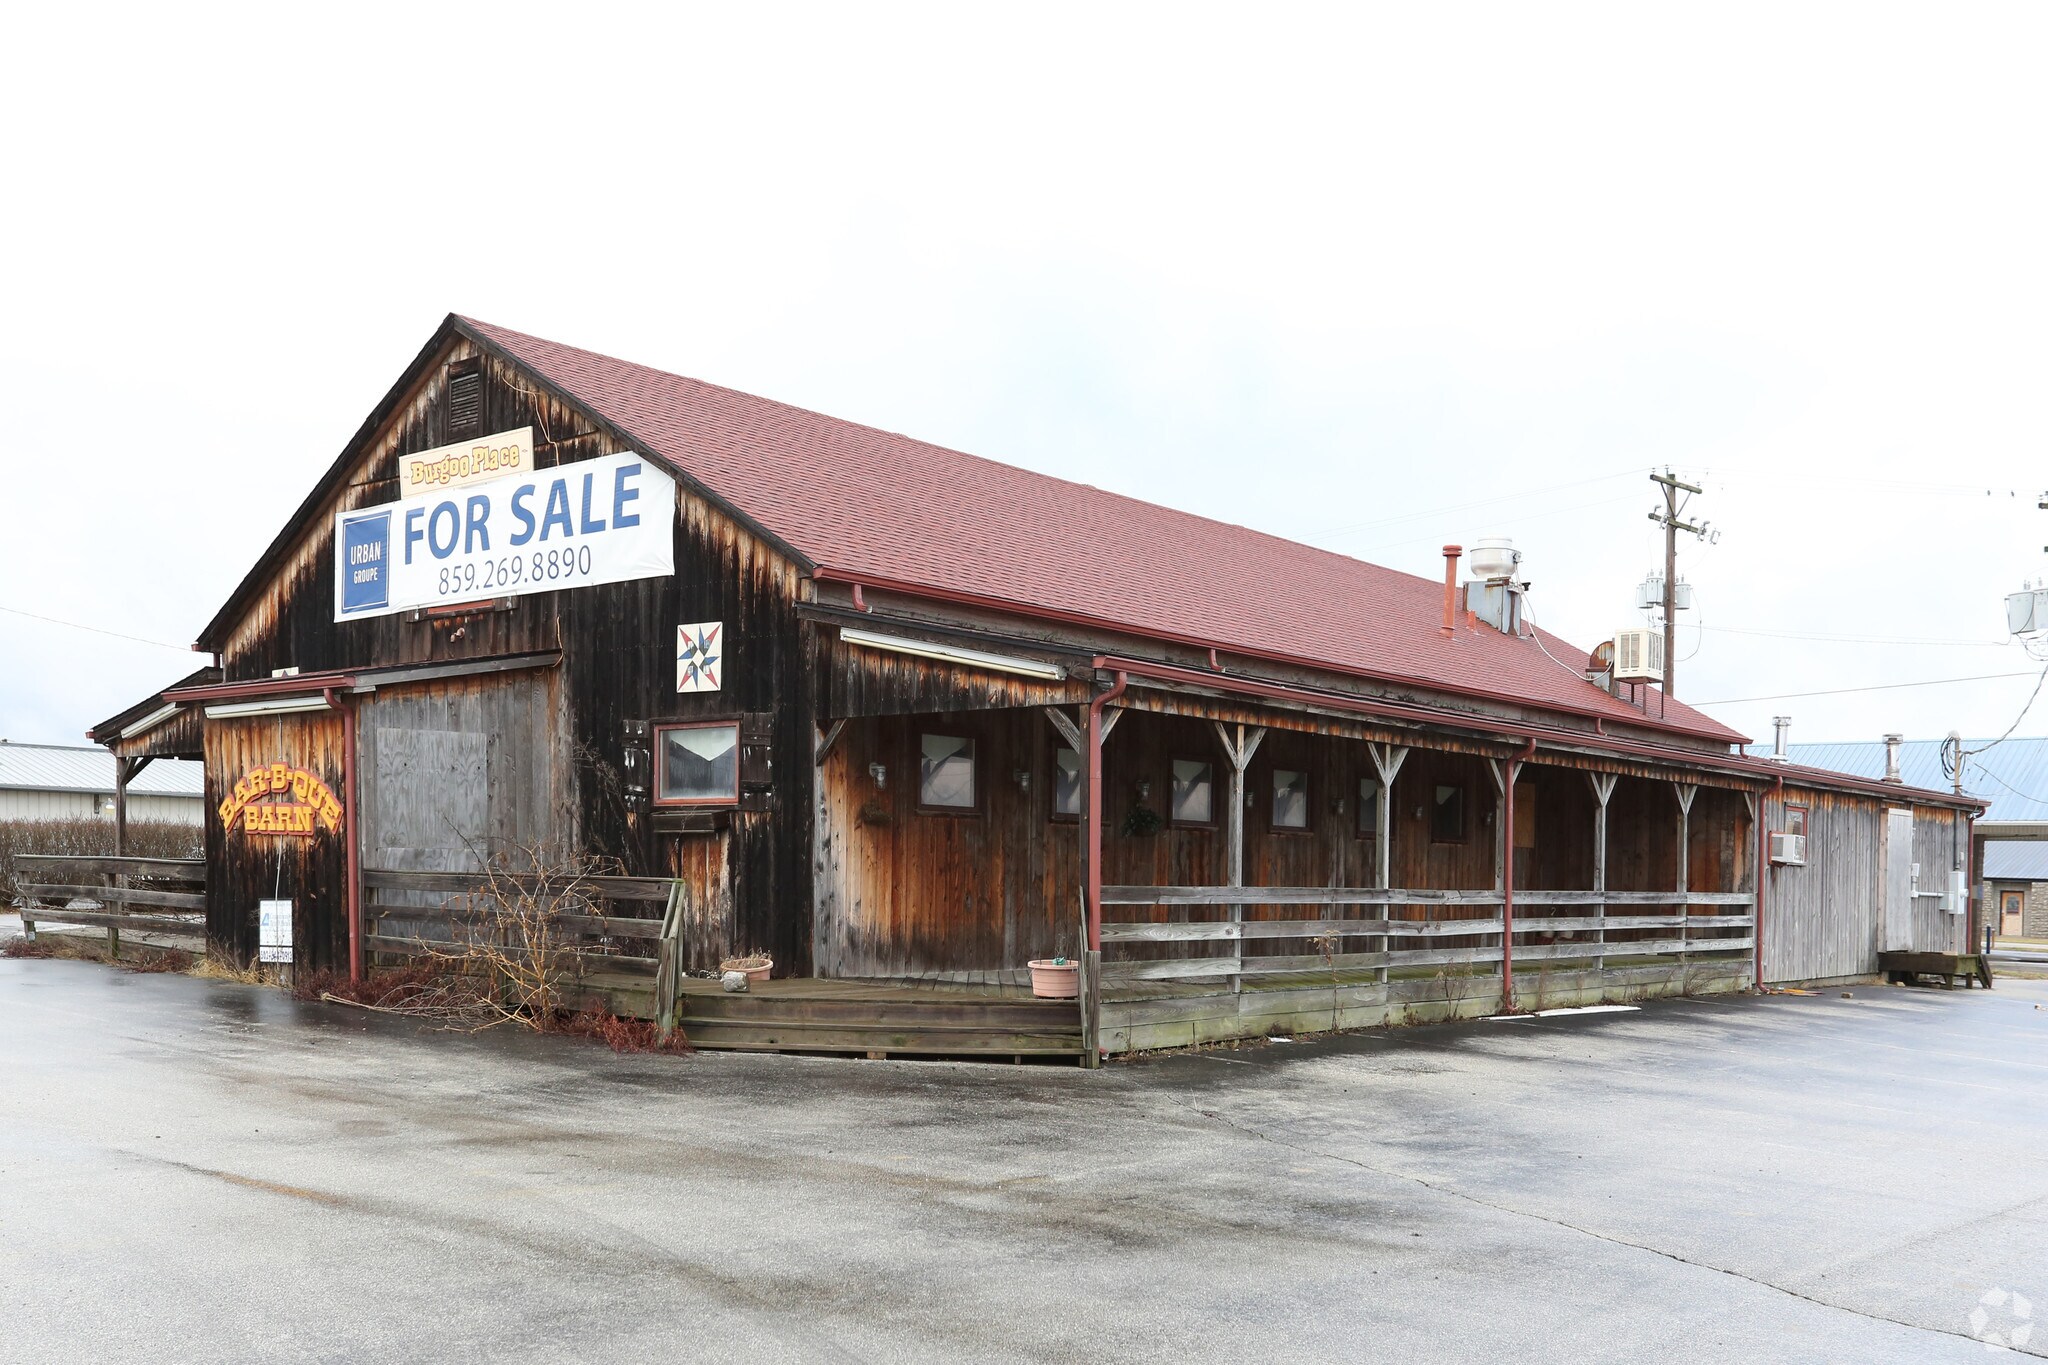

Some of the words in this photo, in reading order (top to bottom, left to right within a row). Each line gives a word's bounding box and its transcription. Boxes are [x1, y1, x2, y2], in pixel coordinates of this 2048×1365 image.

[411, 454, 470, 485] Burgoo
[472, 444, 520, 474] Place
[404, 494, 491, 566] FOR
[509, 463, 642, 546] SALE
[350, 541, 381, 566] URBAN
[438, 544, 592, 595] 859.269.8890
[353, 567, 378, 584] GROUPE
[218, 762, 344, 832] BAR-B-QUE
[244, 804, 314, 834] BARN
